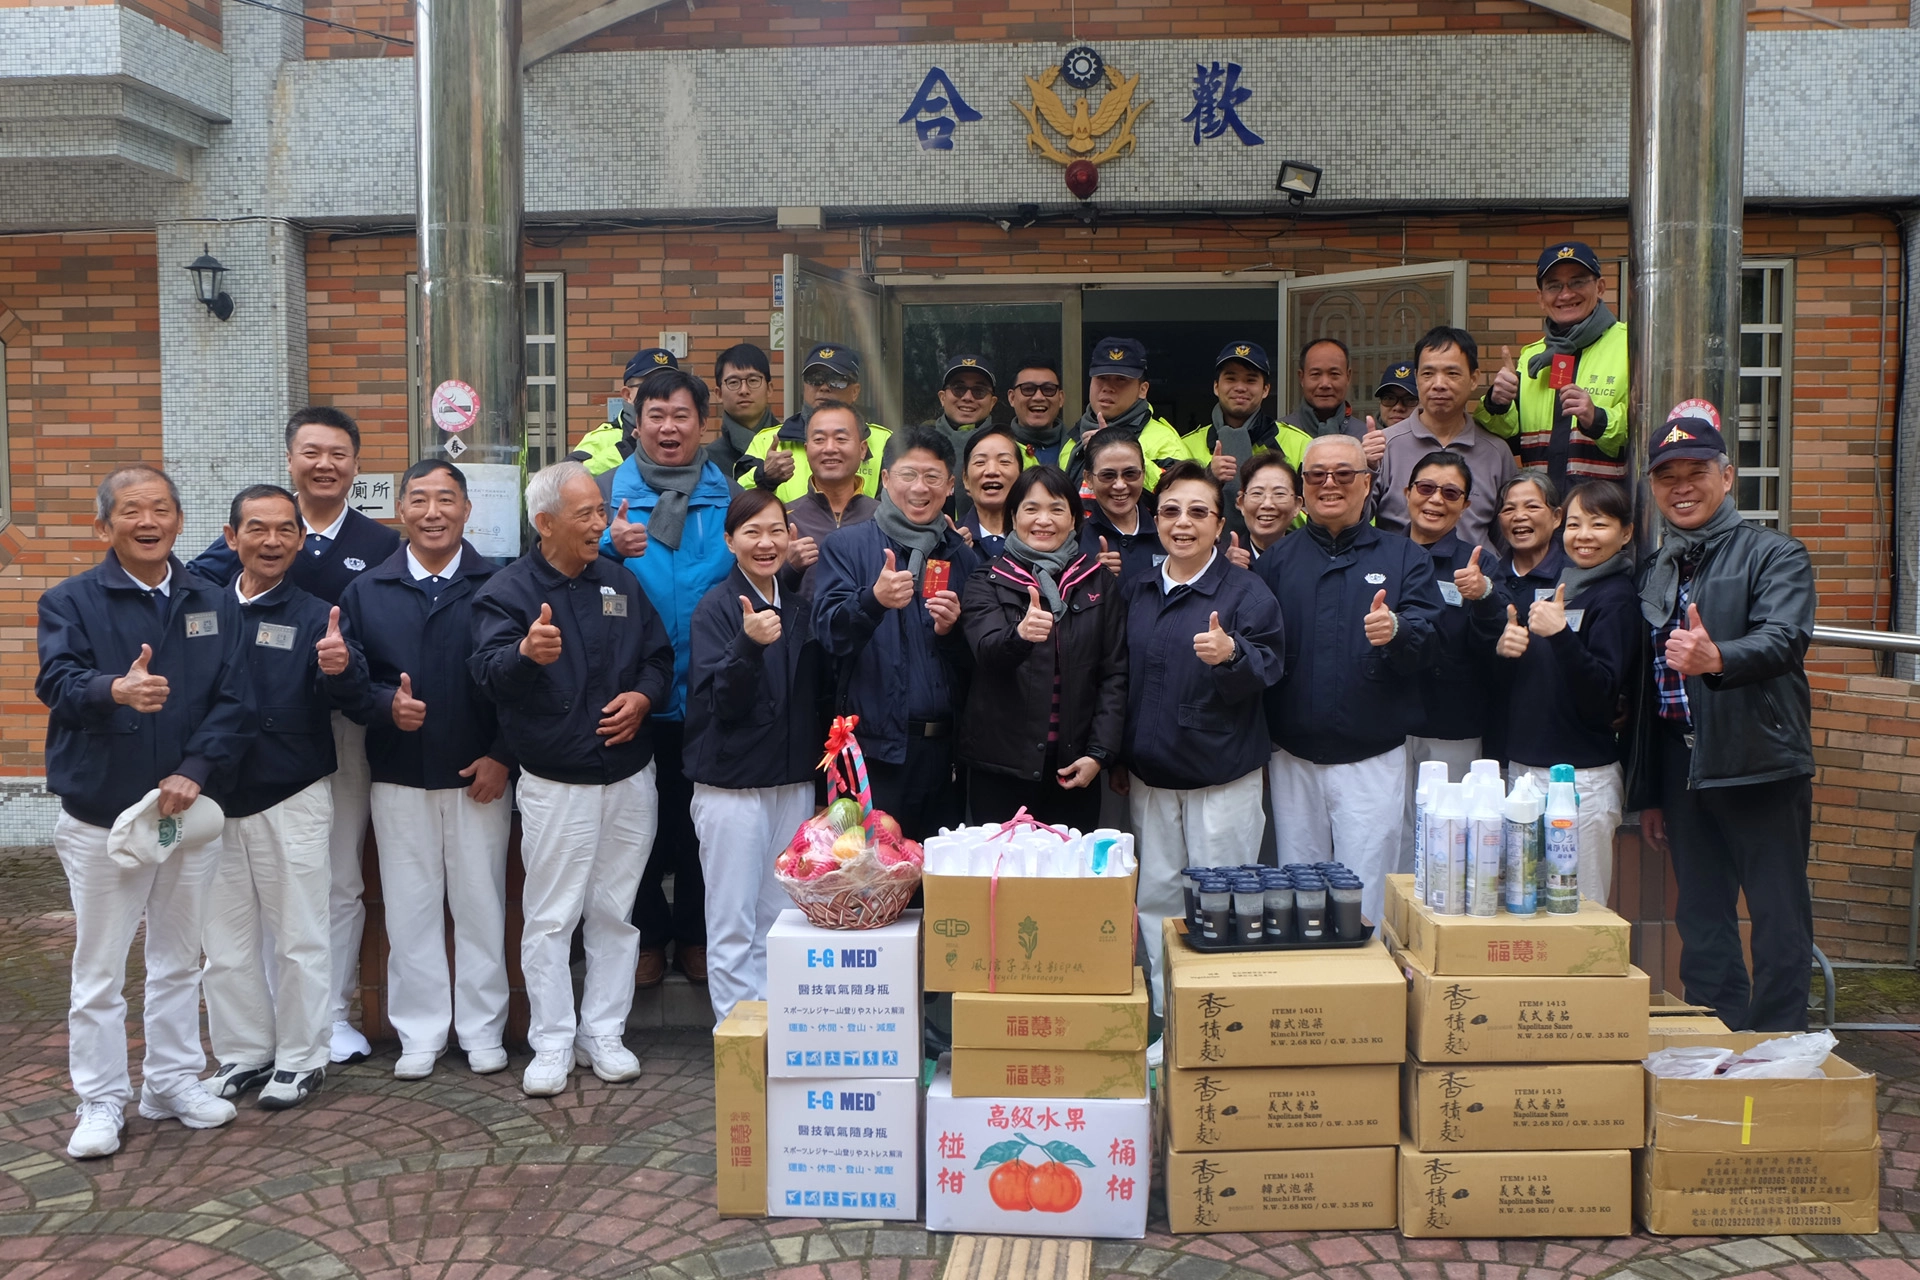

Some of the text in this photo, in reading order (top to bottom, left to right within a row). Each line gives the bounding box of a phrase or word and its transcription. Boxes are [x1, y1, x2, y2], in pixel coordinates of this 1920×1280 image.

[899, 61, 1264, 151] 合 歡
[1590, 375, 1615, 384] 警 察
[450, 440, 463, 453] 春
[350, 481, 390, 499] 廁所
[808, 948, 834, 968] E-G
[798, 984, 889, 995] 醫技氧氣隨身瓶
[1270, 1018, 1324, 1029] 韓式泡菜
[807, 1091, 833, 1110] E-G
[987, 1104, 1086, 1132] 高級水果
[798, 1125, 888, 1138] 醫技氧氣隨身瓶
[1106, 1137, 1135, 1202] 桶柑
[1261, 1183, 1316, 1195] 韓式泡菜
